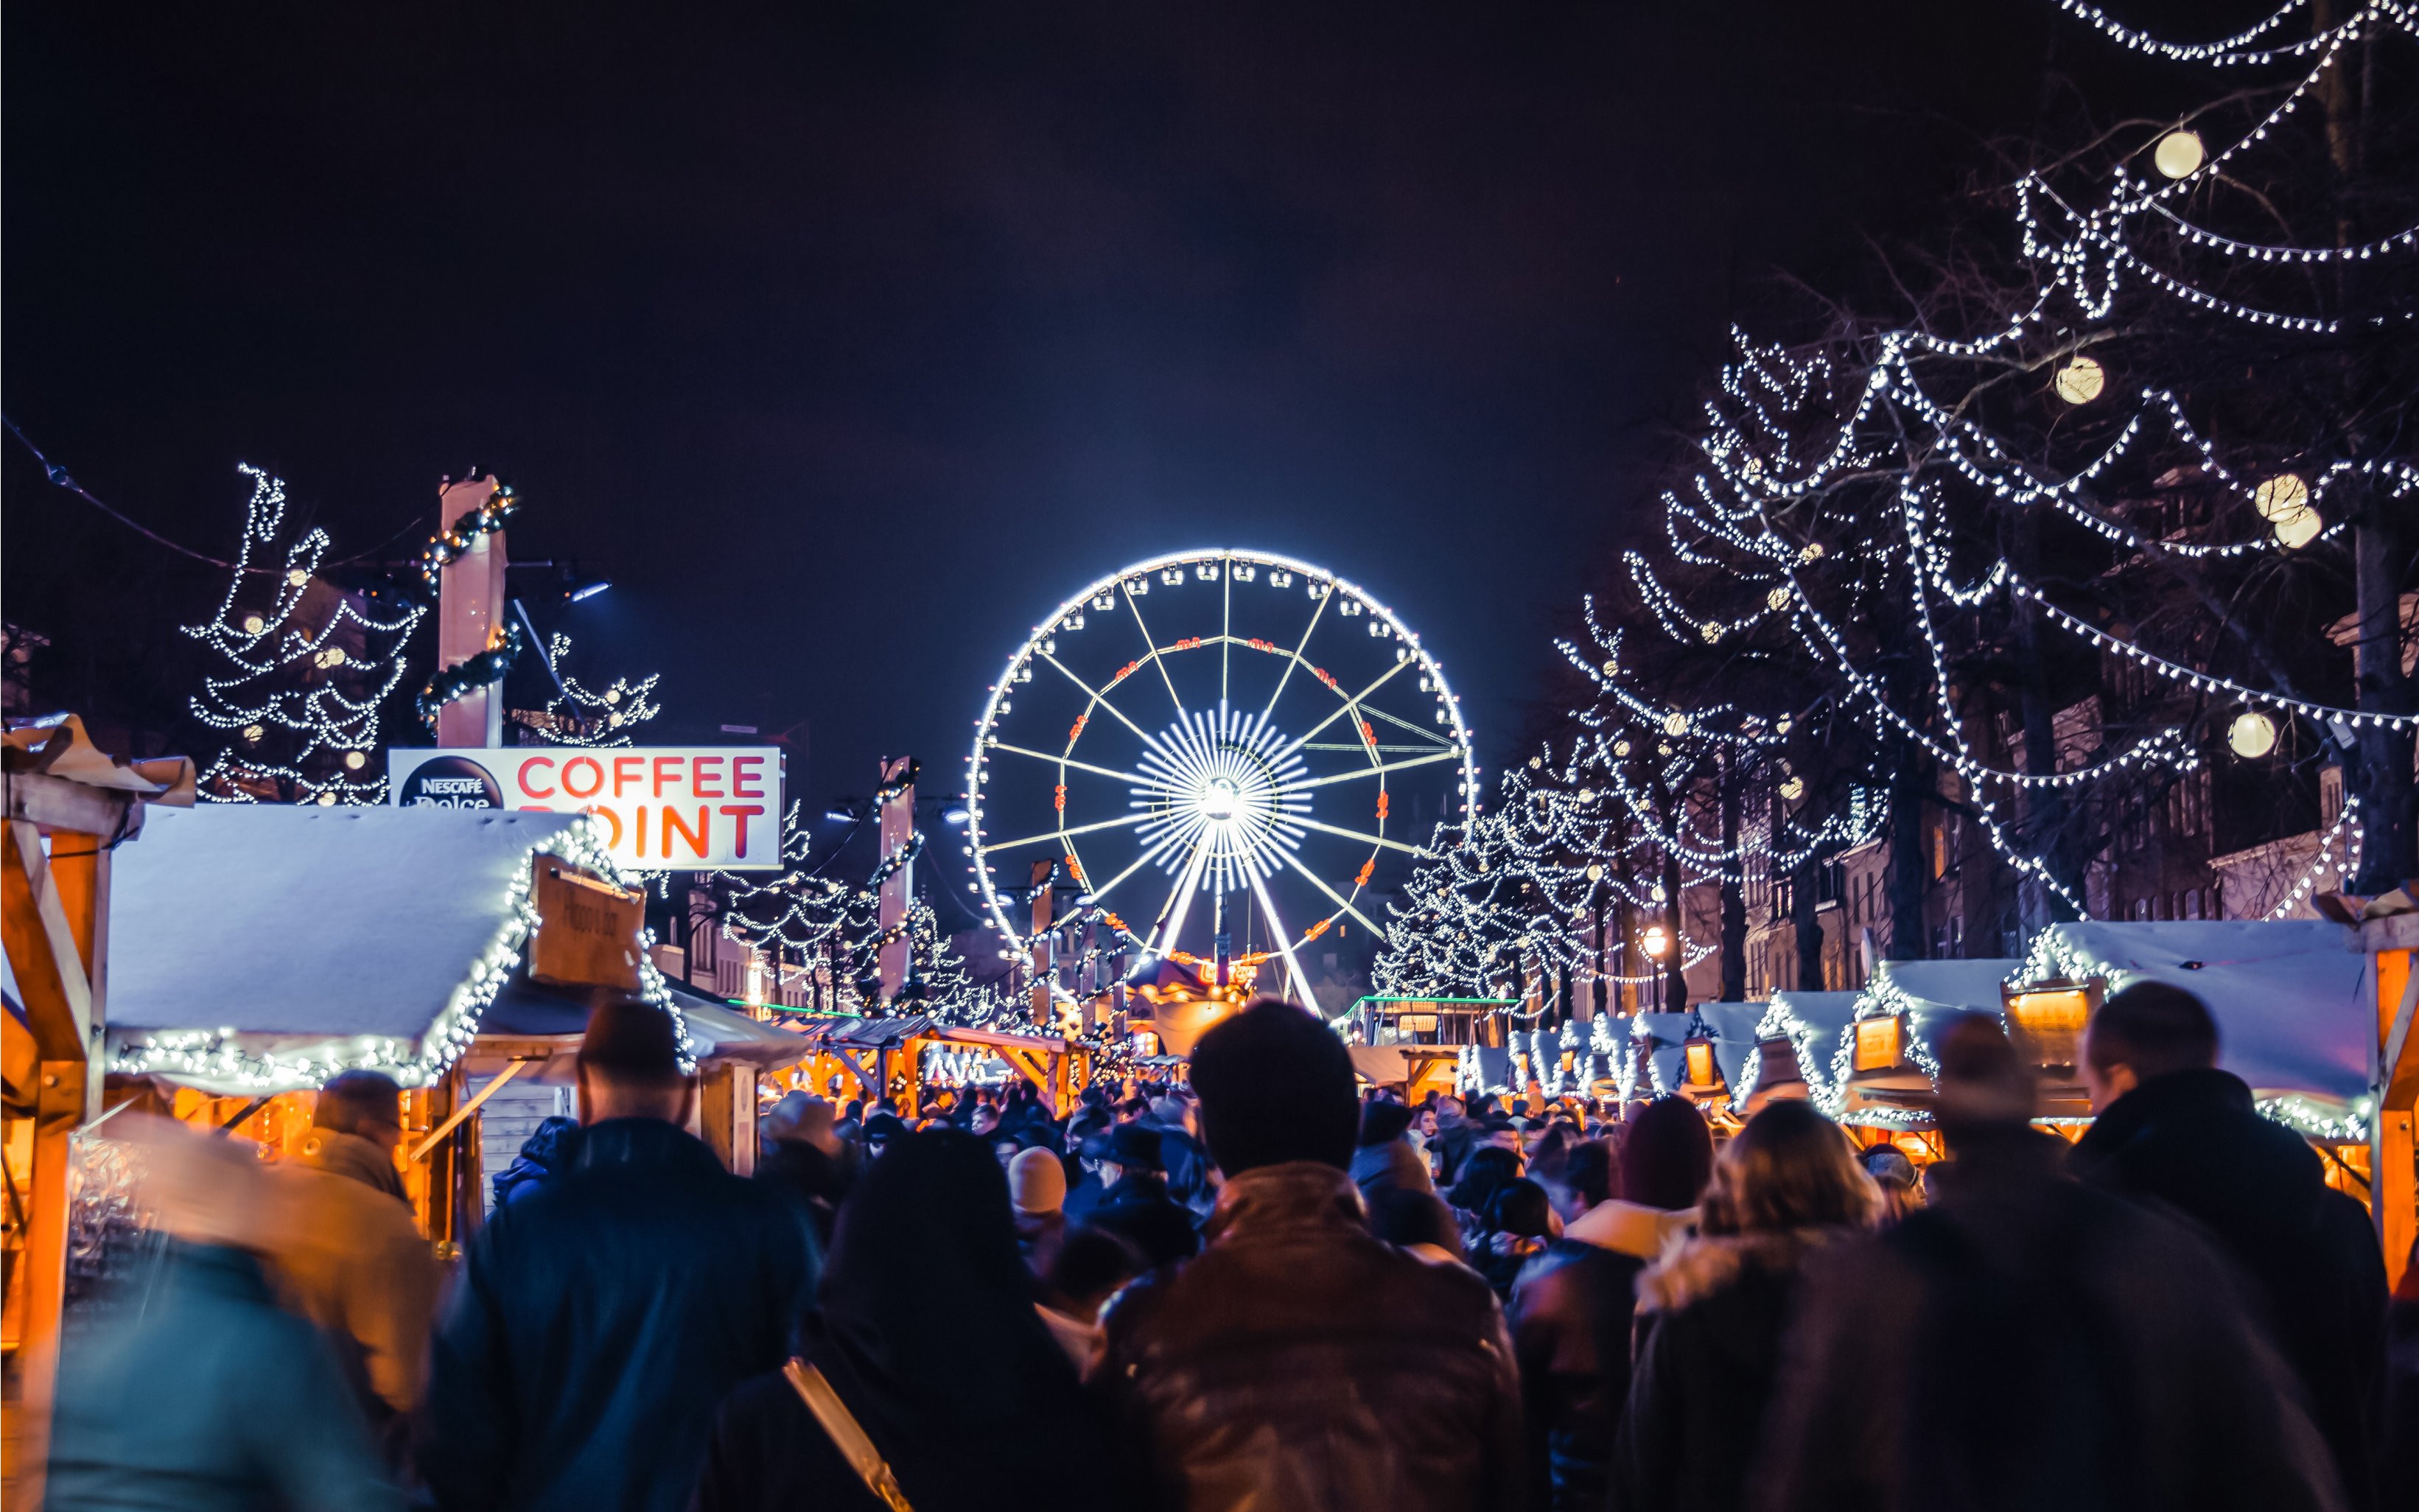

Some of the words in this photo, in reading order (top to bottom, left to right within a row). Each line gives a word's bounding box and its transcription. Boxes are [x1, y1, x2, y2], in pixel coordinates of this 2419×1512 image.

[421, 778, 483, 794] NESCAFÉ
[518, 757, 765, 799] COFFEE
[518, 805, 765, 859] OINT
